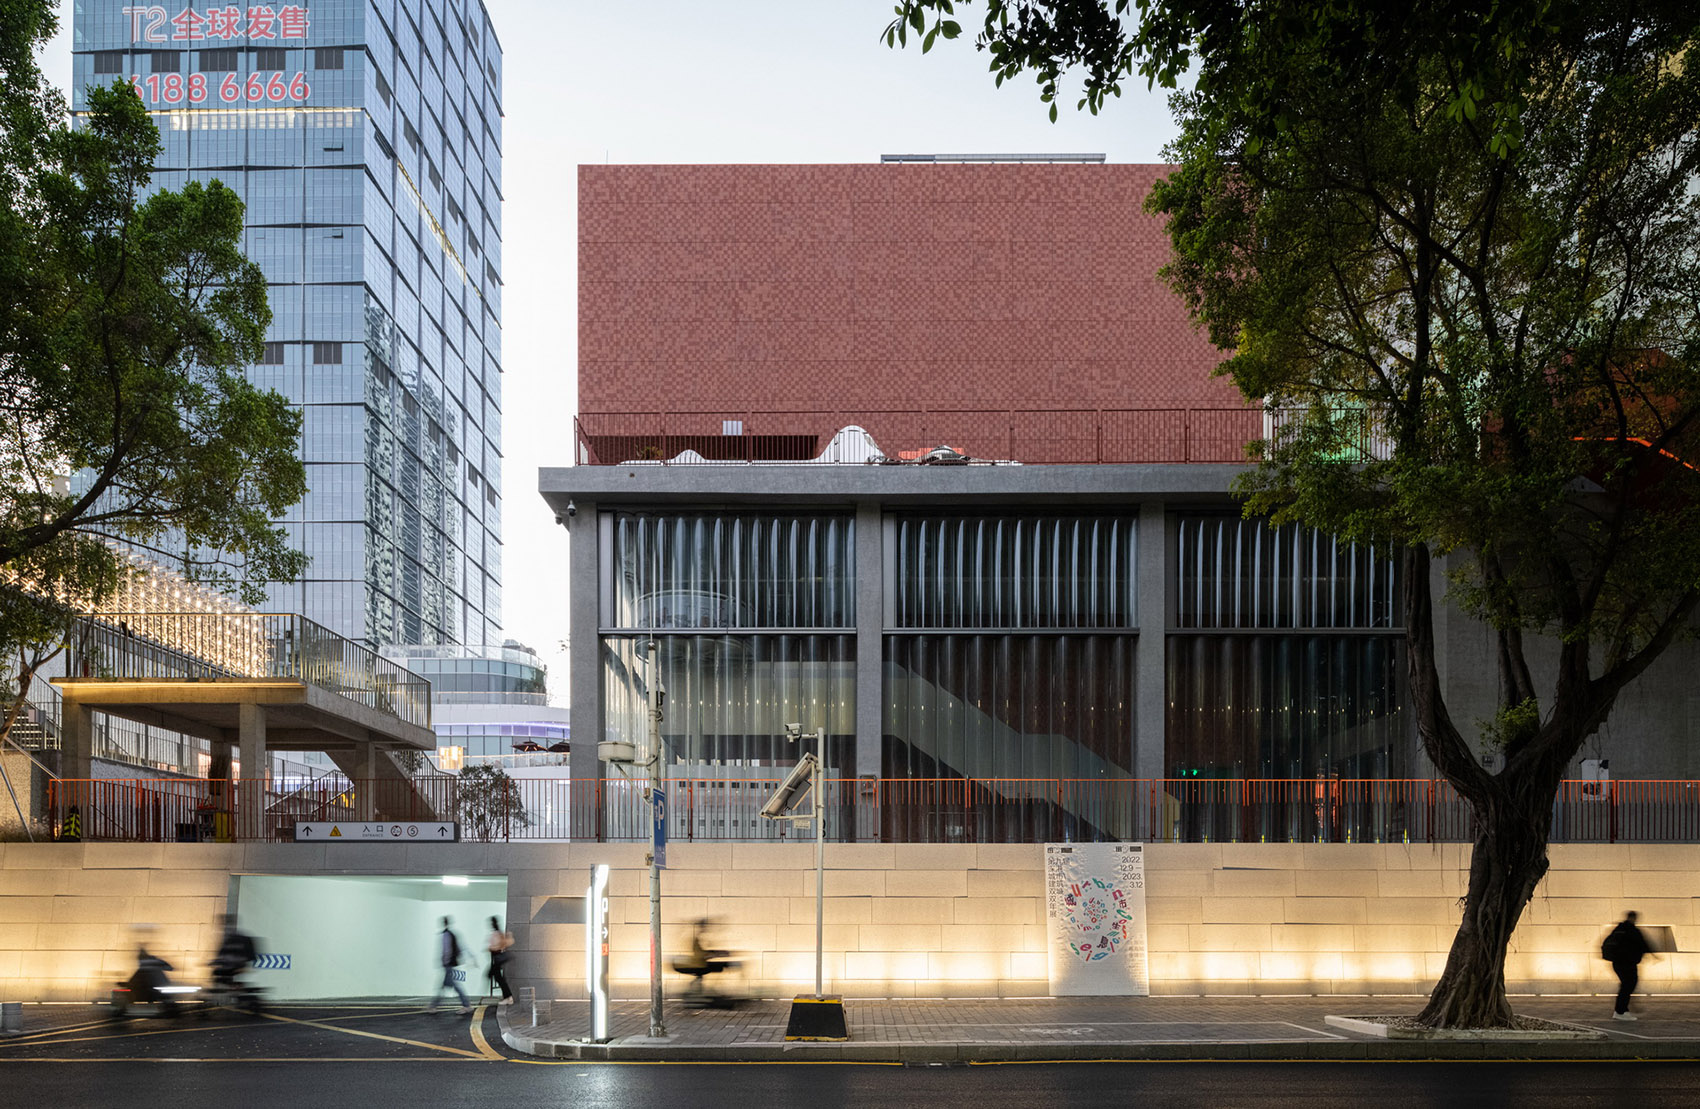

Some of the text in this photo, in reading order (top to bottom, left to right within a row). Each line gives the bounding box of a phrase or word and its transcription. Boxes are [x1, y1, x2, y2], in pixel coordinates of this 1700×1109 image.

[219, 71, 311, 102] 6666
[658, 800, 665, 830] P
[1129, 881, 1143, 889] 3.12
[602, 898, 608, 923] P
